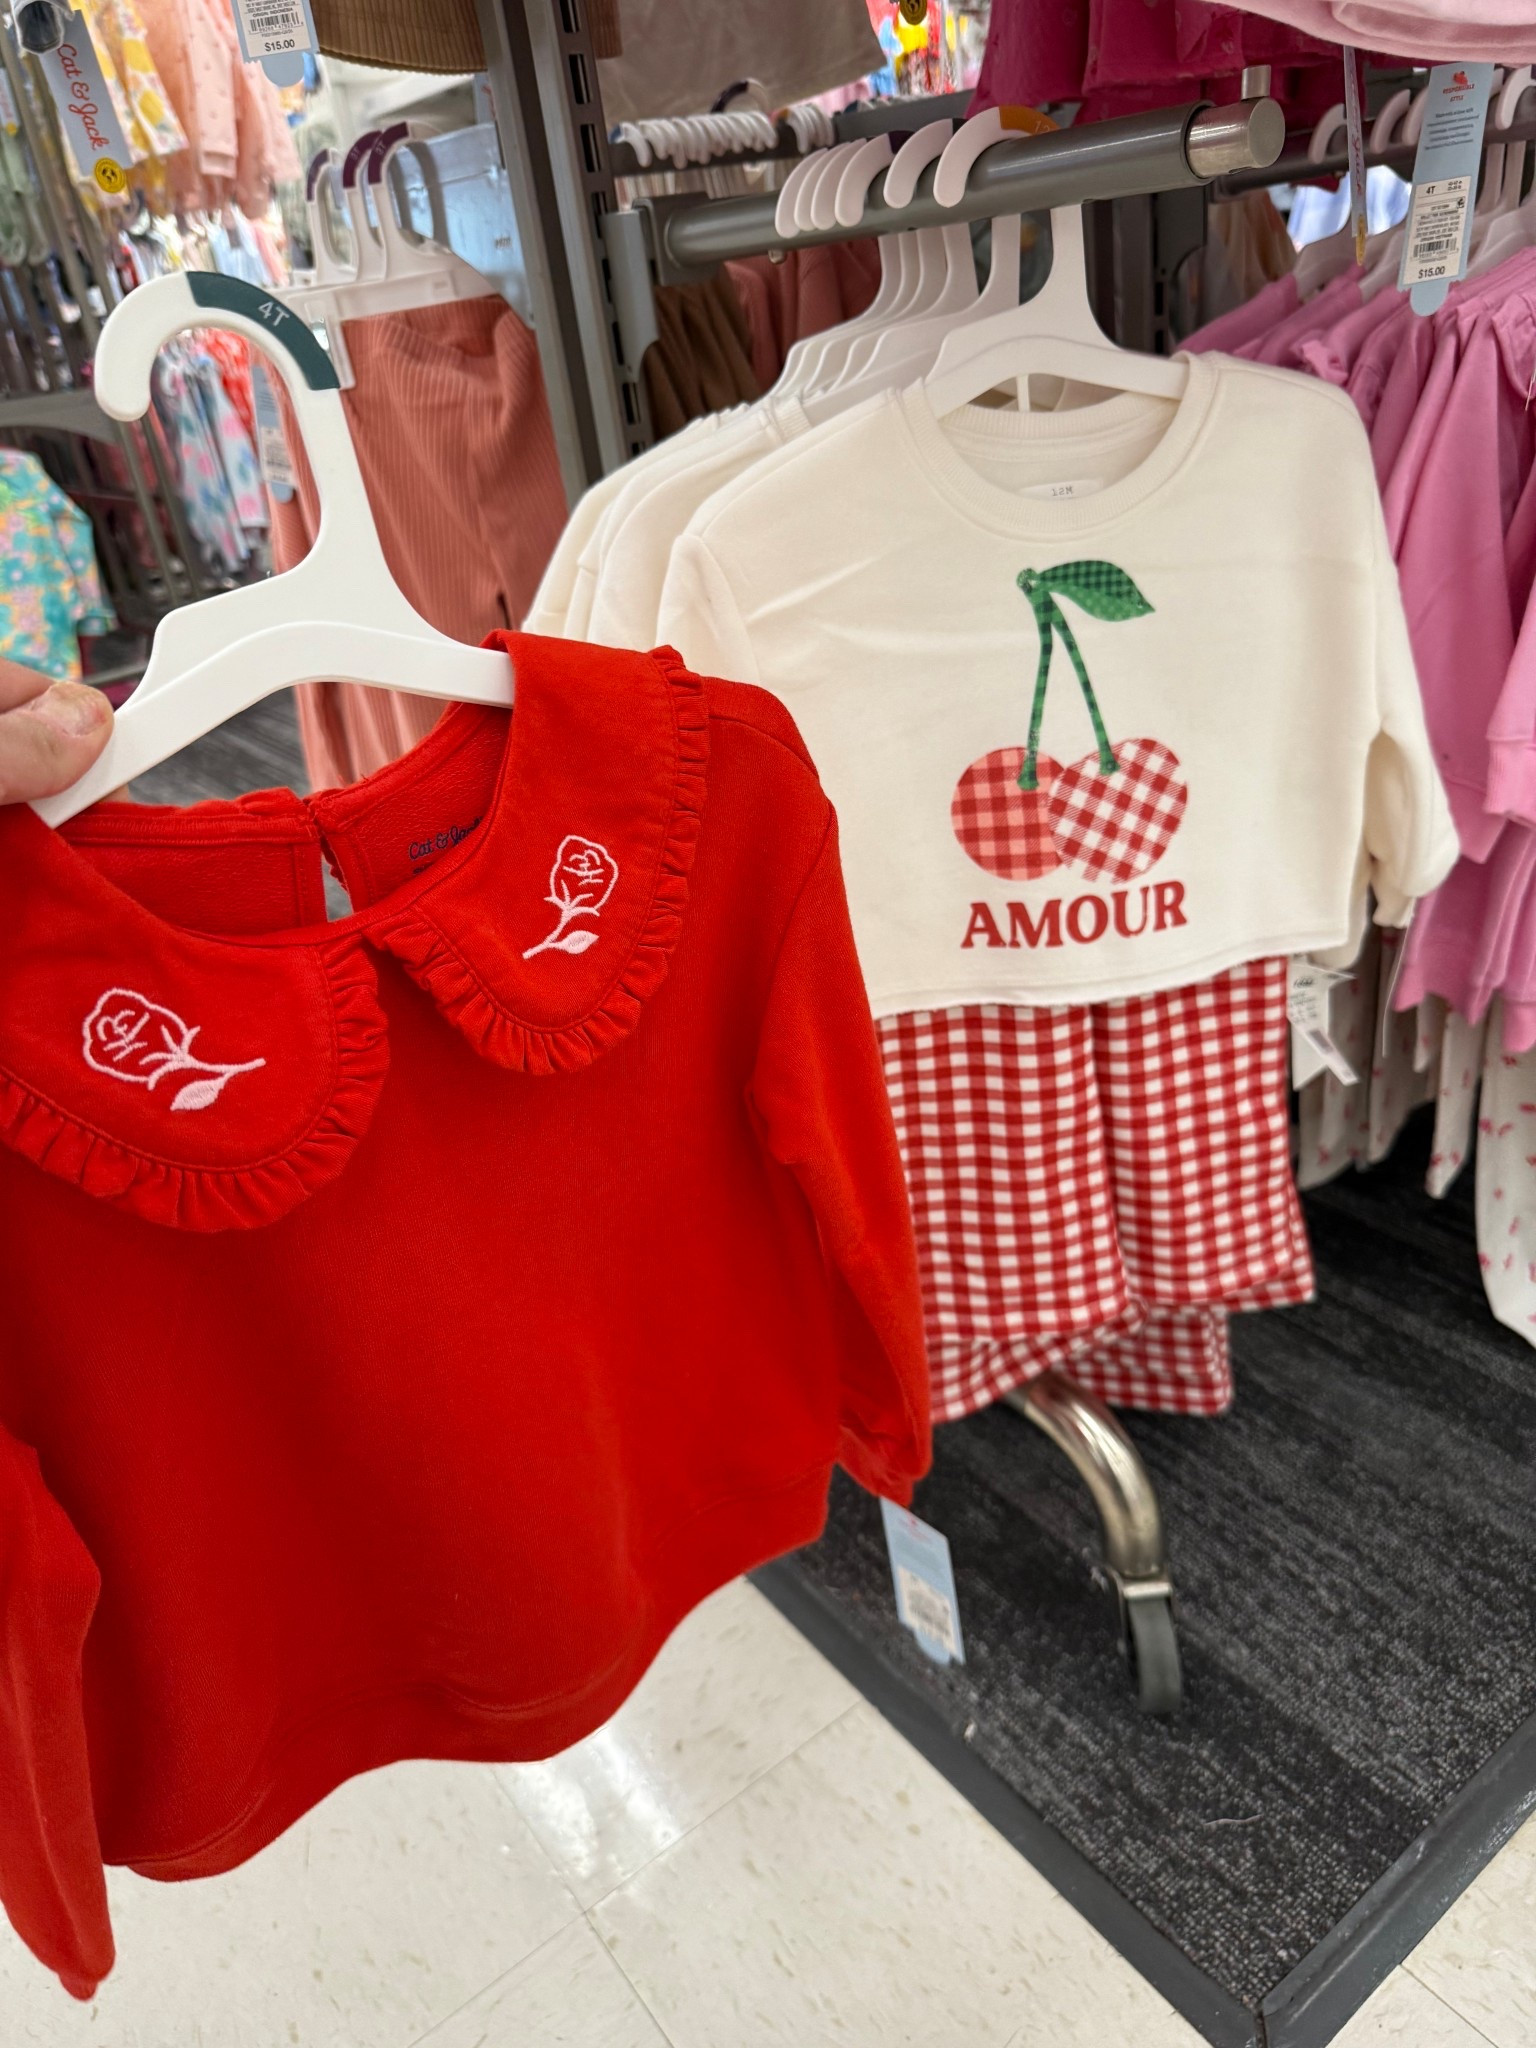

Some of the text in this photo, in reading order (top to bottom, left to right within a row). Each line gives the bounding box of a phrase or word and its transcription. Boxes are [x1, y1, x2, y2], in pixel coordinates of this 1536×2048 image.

[264, 39, 295, 52] $15.00
[57, 43, 109, 151] Cat & Jack
[1425, 185, 1436, 195] 4T
[1418, 266, 1446, 279] $15.00
[258, 301, 290, 327] 4T
[1052, 485, 1074, 497] 12M
[408, 837, 435, 860] Cat
[436, 833, 449, 849] &
[960, 880, 1188, 949] AMOUR
